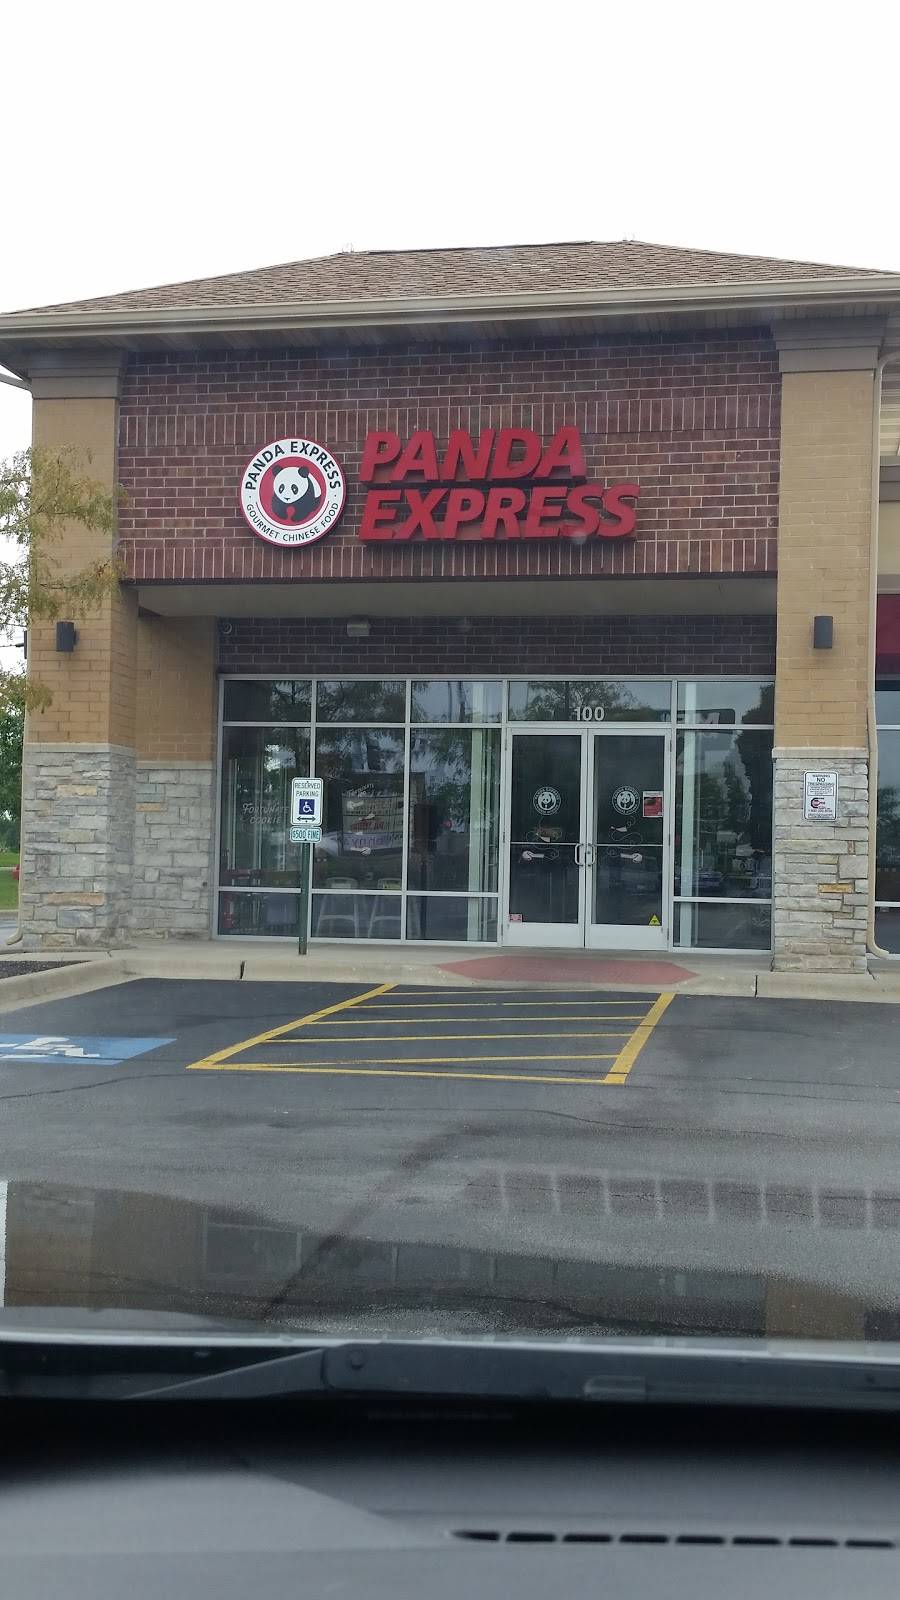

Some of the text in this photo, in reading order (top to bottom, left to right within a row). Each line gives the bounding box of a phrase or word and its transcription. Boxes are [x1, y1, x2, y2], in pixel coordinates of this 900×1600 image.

[245, 441, 341, 490] PANDA EXPRESS
[359, 426, 587, 482] PANDA
[246, 502, 339, 542] GOURMET CHINESE FOOD
[358, 484, 640, 540] EXPRESS
[574, 706, 605, 721] 100
[294, 782, 321, 790] RESERVED
[292, 830, 320, 839] $500 FINE
